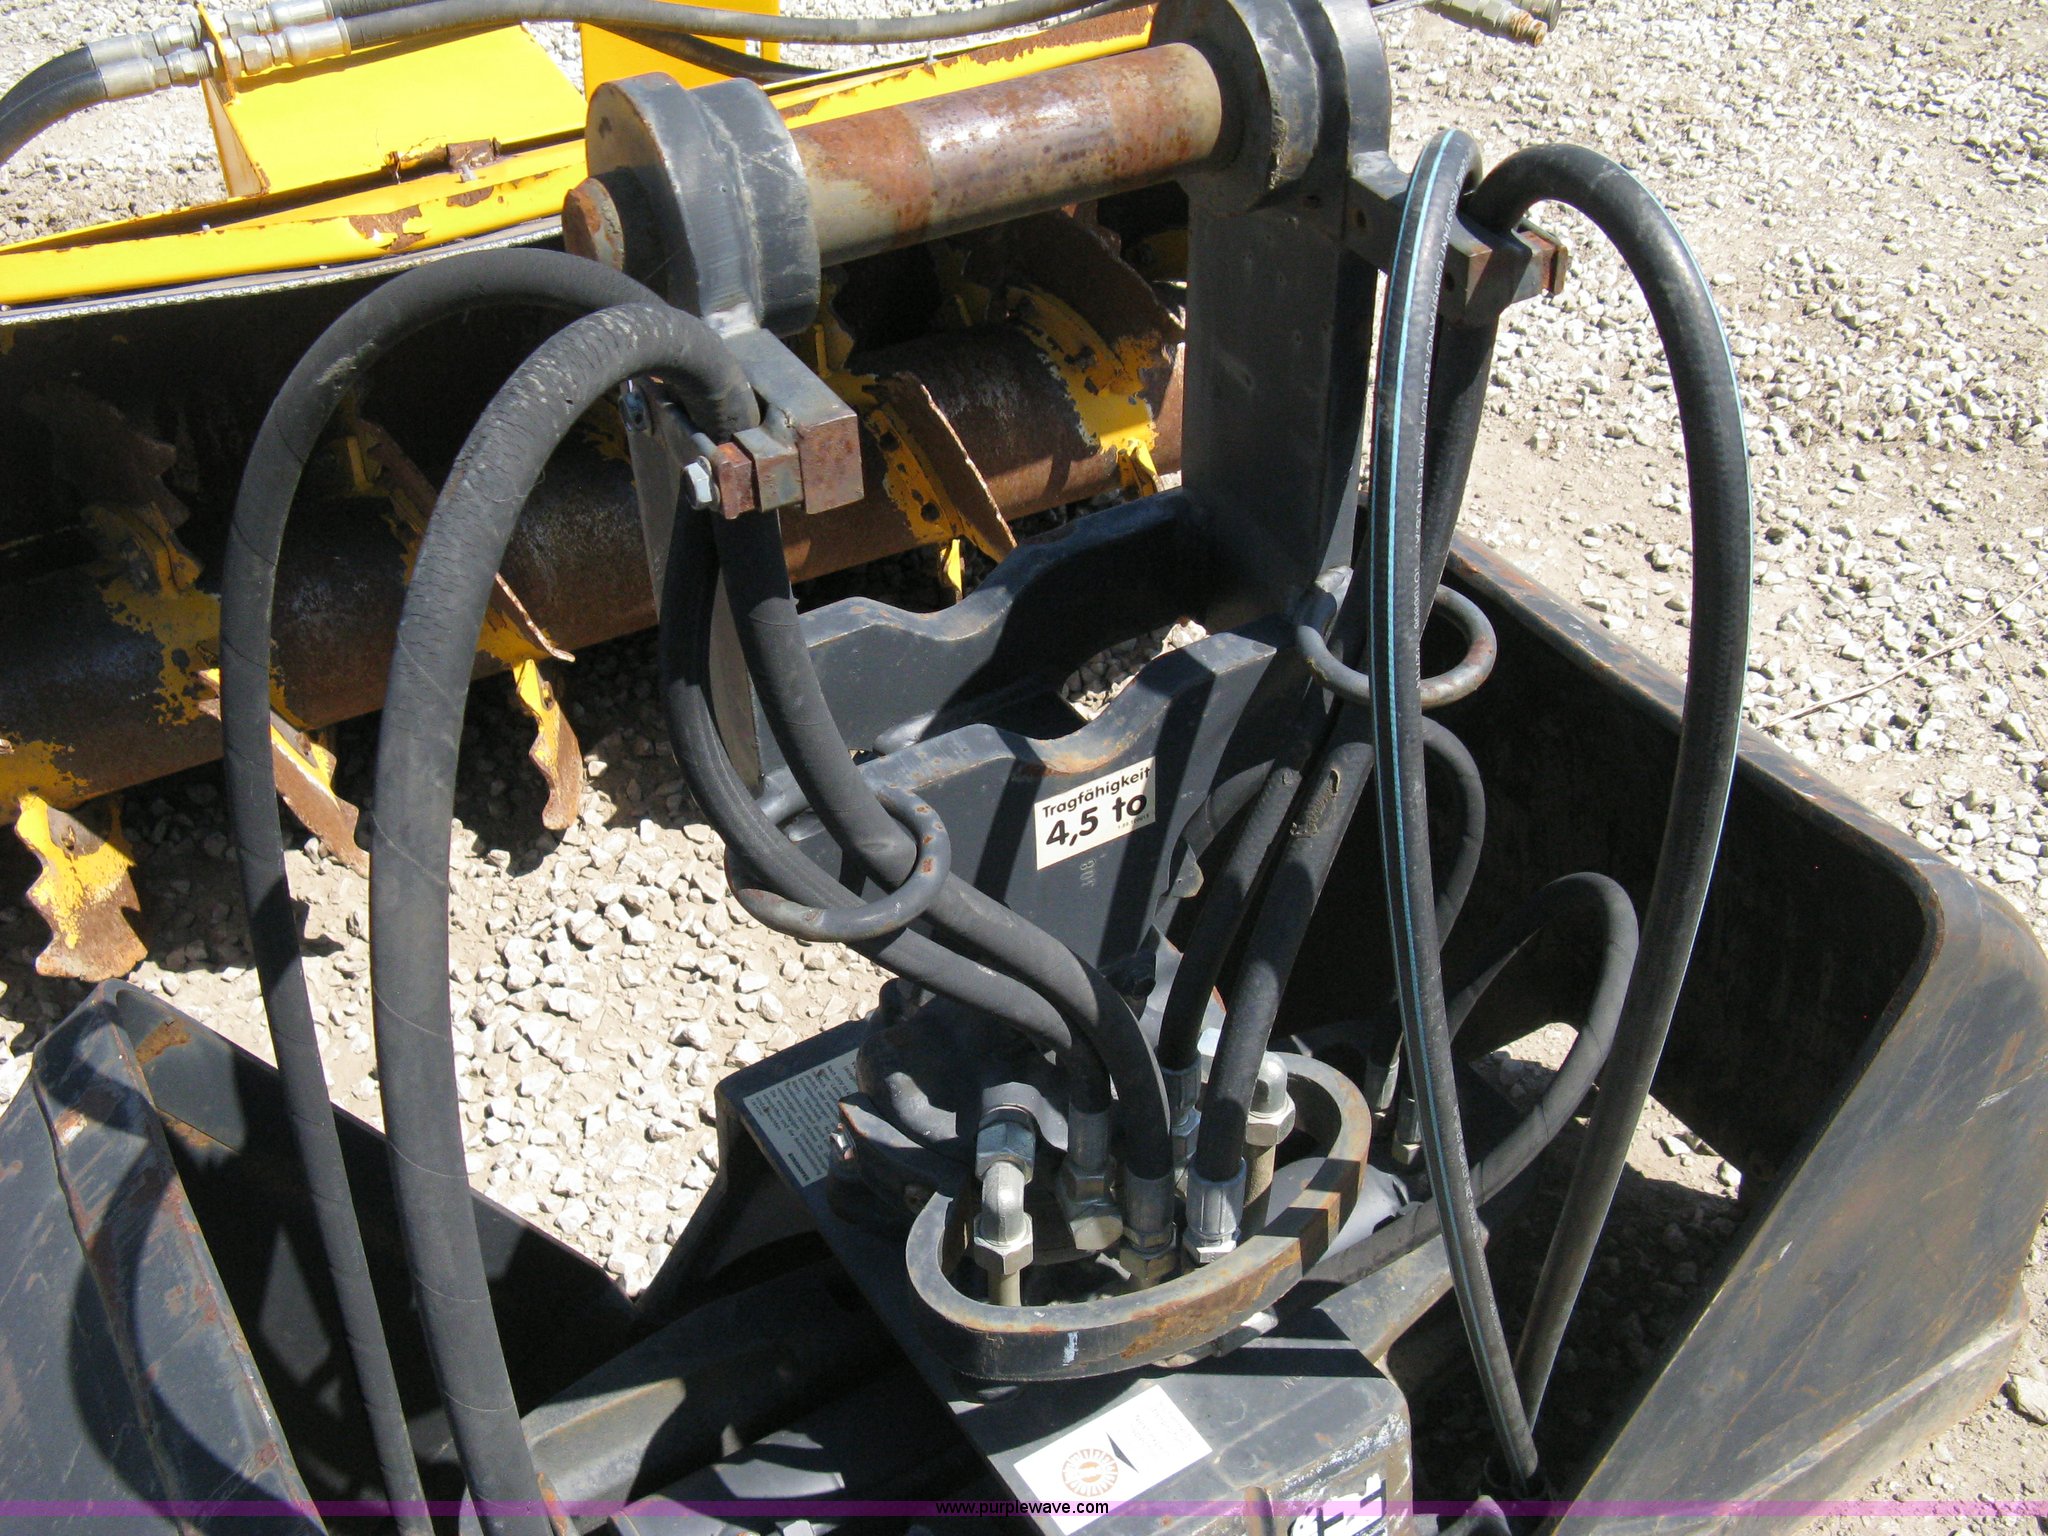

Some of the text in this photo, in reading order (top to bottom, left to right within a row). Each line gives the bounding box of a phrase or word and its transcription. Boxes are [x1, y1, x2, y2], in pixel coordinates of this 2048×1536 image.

[1042, 766, 1151, 818] Tragfähigkeit
[1046, 806, 1099, 846] 4,5
[1112, 794, 1148, 823] to
